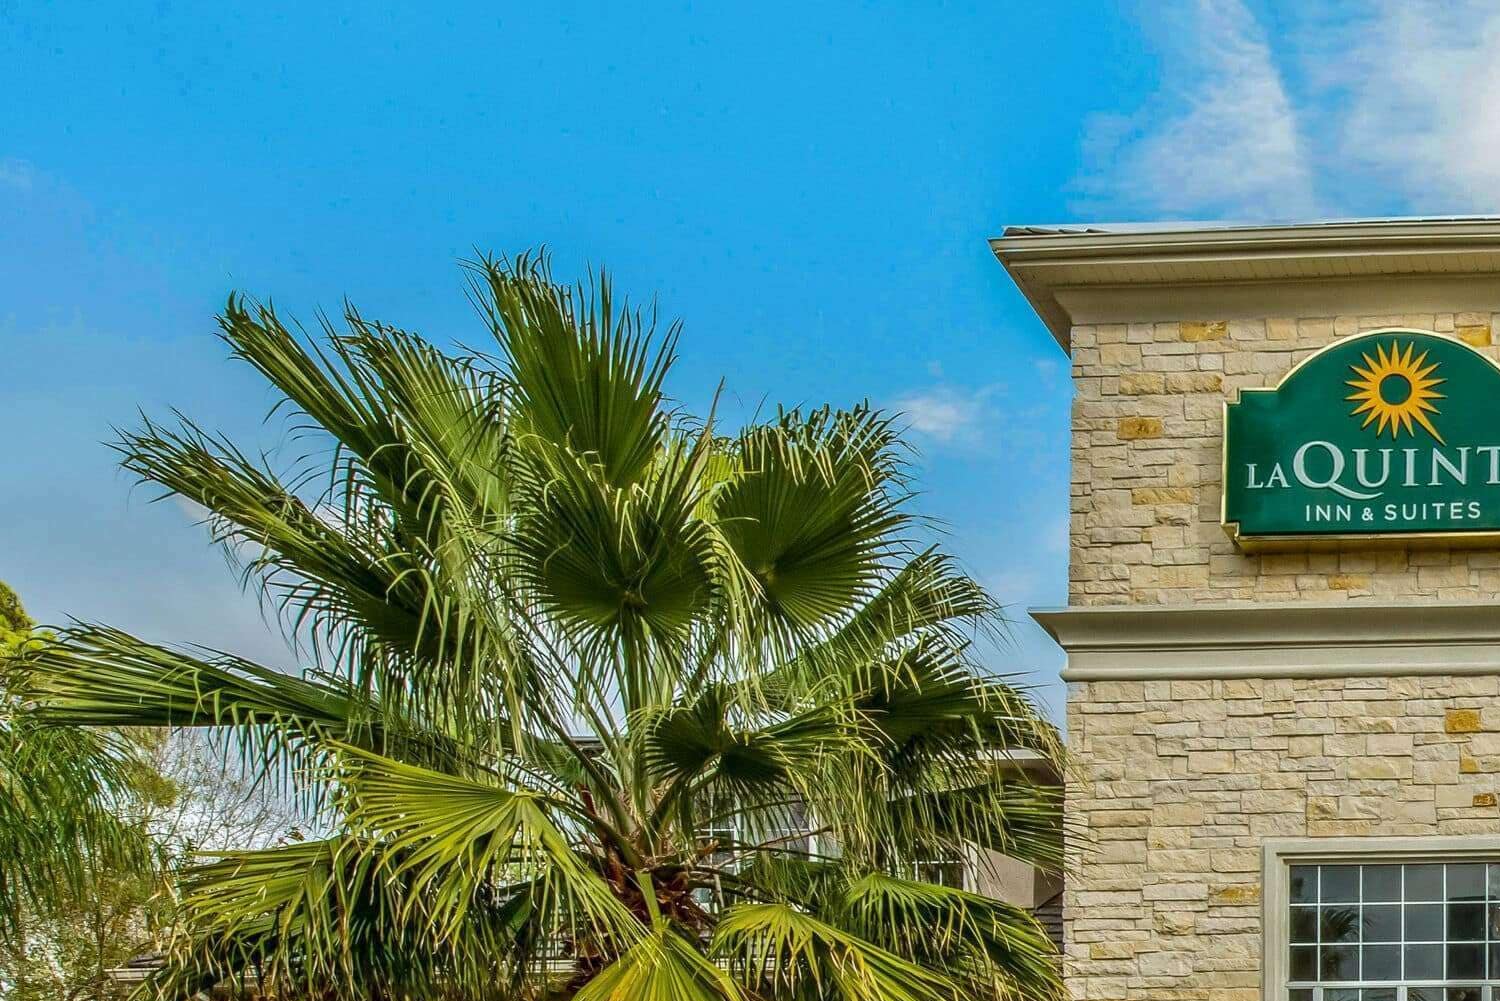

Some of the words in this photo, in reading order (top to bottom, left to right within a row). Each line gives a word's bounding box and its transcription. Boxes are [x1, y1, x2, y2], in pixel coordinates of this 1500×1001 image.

[1306, 504, 1351, 522] INN
[1361, 508, 1374, 522] &
[1384, 502, 1481, 520] SUITES
